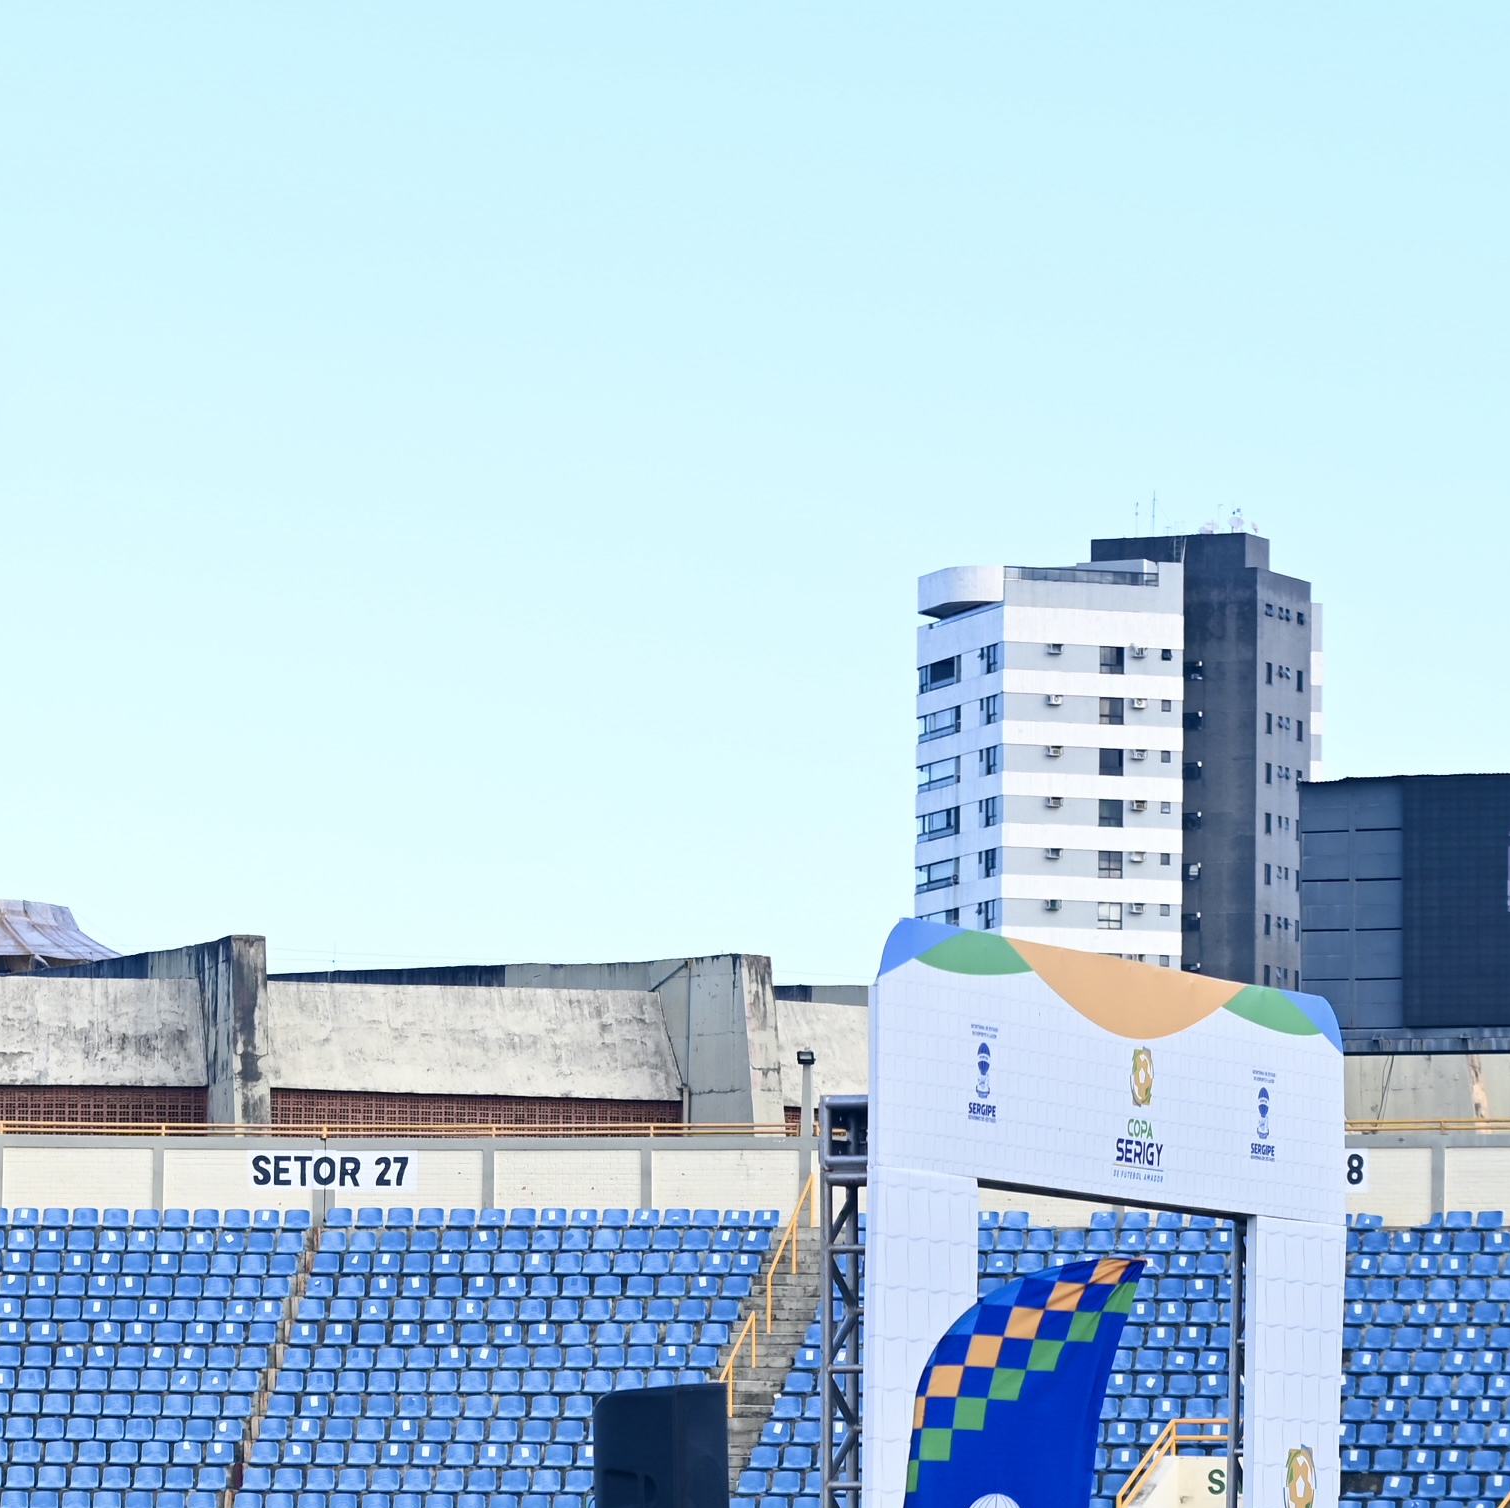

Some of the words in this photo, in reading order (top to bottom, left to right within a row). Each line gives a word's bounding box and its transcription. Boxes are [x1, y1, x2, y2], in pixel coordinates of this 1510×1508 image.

[968, 1102, 996, 1117] SERGIPE
[1127, 1118, 1153, 1140] COPA
[1116, 1138, 1163, 1167] SERIGY
[1251, 1142, 1275, 1157] SERGIPE
[252, 1155, 361, 1187] SETOR
[374, 1156, 409, 1186] 27
